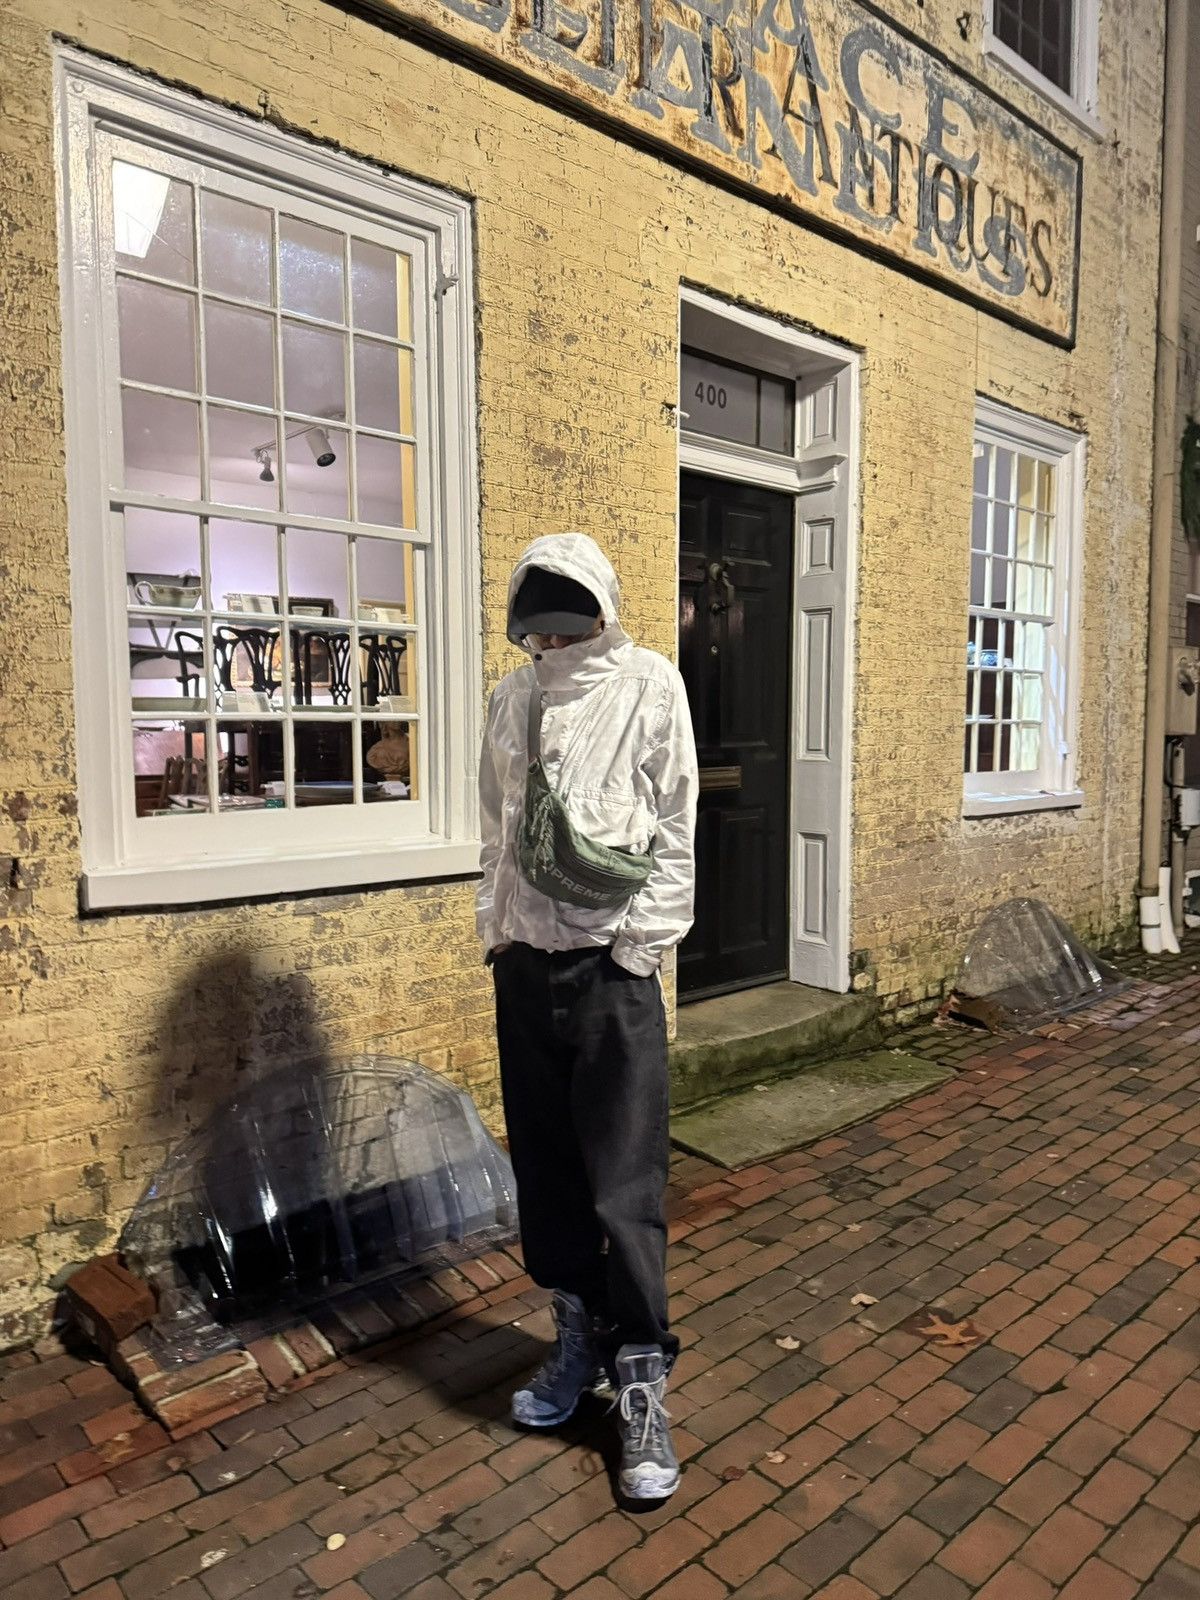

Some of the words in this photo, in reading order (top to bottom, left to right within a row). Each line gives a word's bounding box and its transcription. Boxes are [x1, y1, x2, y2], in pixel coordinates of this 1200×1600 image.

[672, 0, 980, 177] ACE
[763, 33, 1053, 298] ANTIQUES
[694, 381, 728, 409] 400
[547, 864, 612, 901] PREME
